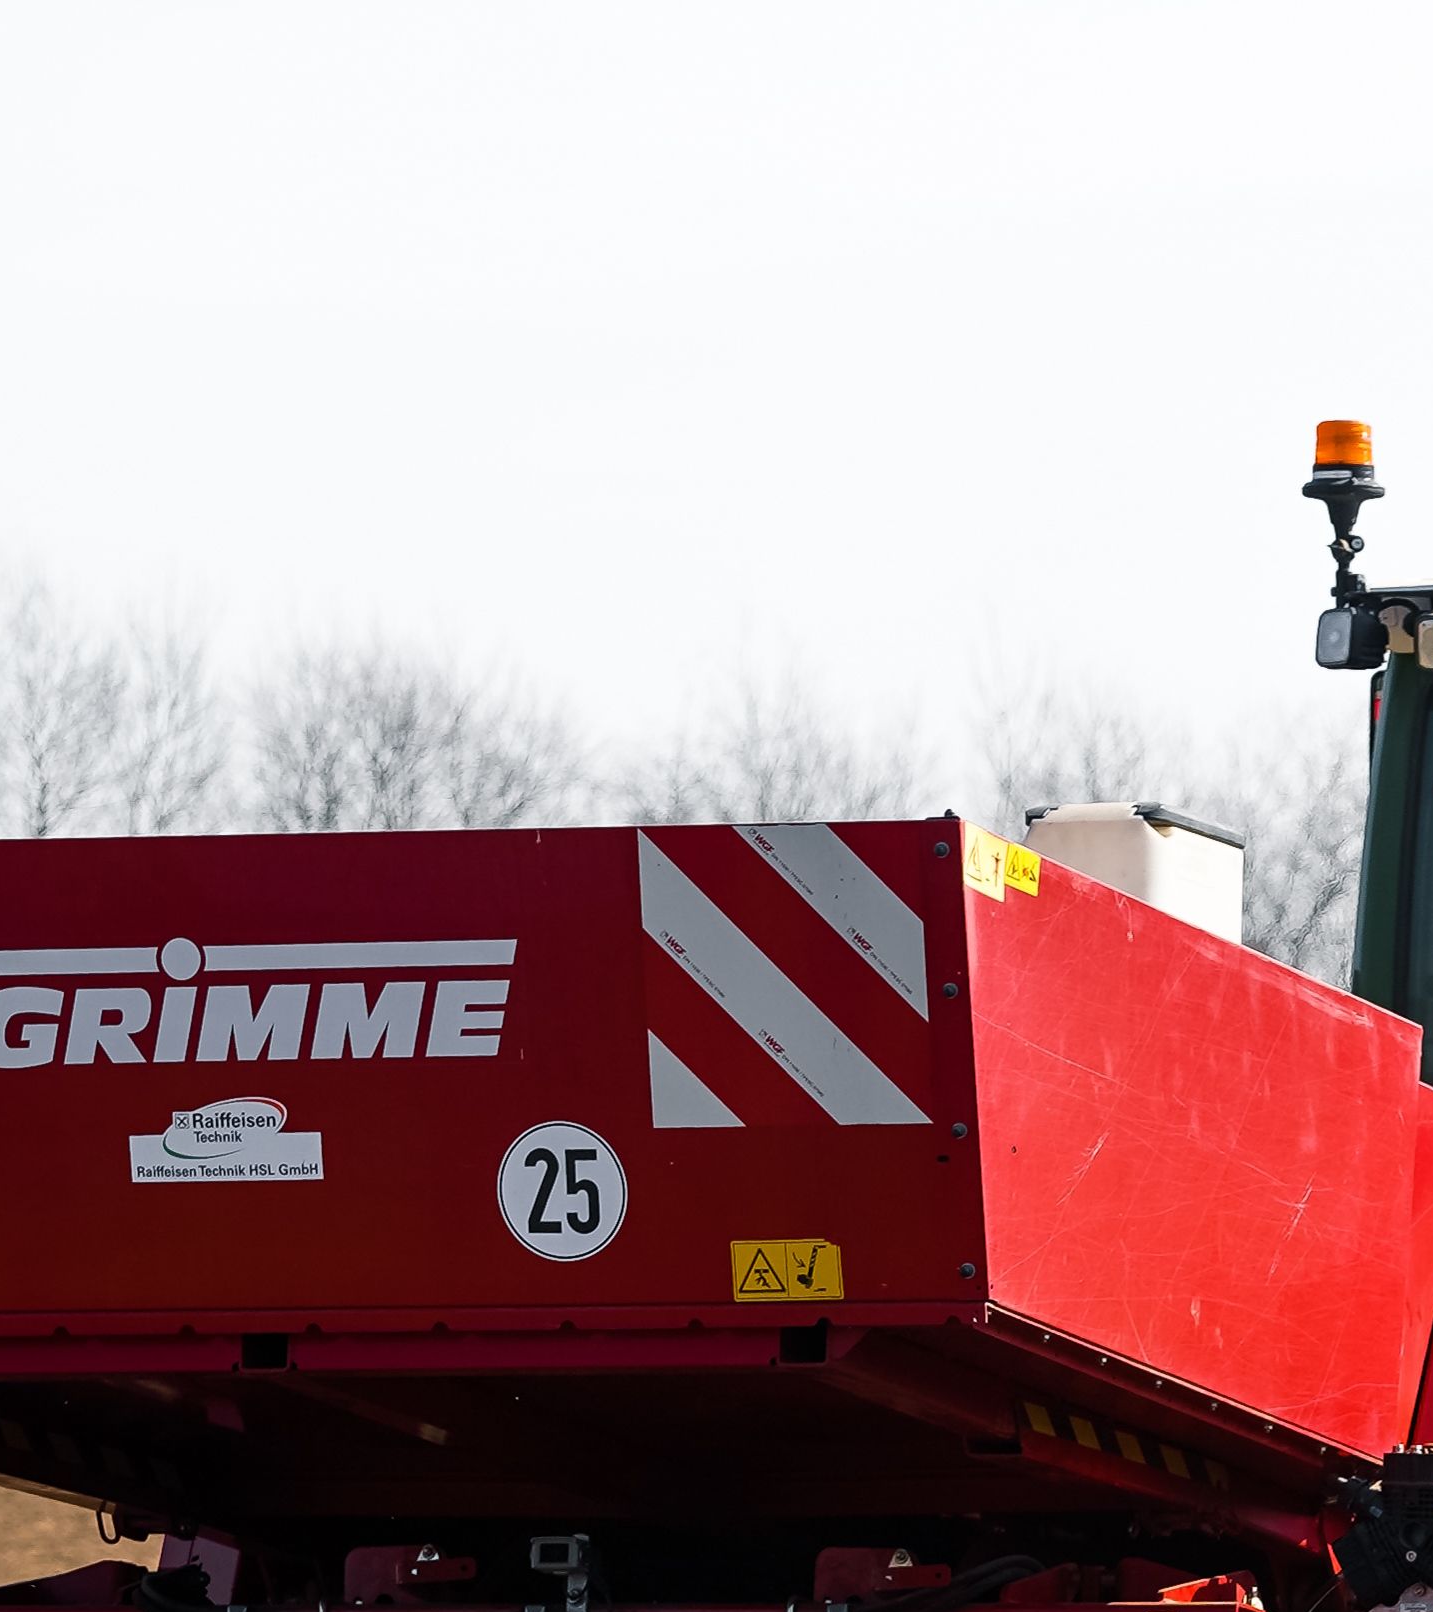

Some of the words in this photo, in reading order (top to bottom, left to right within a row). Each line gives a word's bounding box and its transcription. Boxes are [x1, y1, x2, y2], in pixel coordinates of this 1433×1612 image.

[755, 833, 775, 853] WGF
[666, 936, 687, 955] WGF
[853, 932, 874, 951] WGF
[765, 1035, 786, 1054] WGF
[192, 1112, 277, 1129] Raiffeisen
[193, 1131, 243, 1144] Technik
[136, 1163, 197, 1178] Raiffeisen
[198, 1164, 246, 1178] Technik
[249, 1163, 275, 1177] HSL
[278, 1162, 319, 1176] GmbH
[523, 1147, 601, 1235] 25
